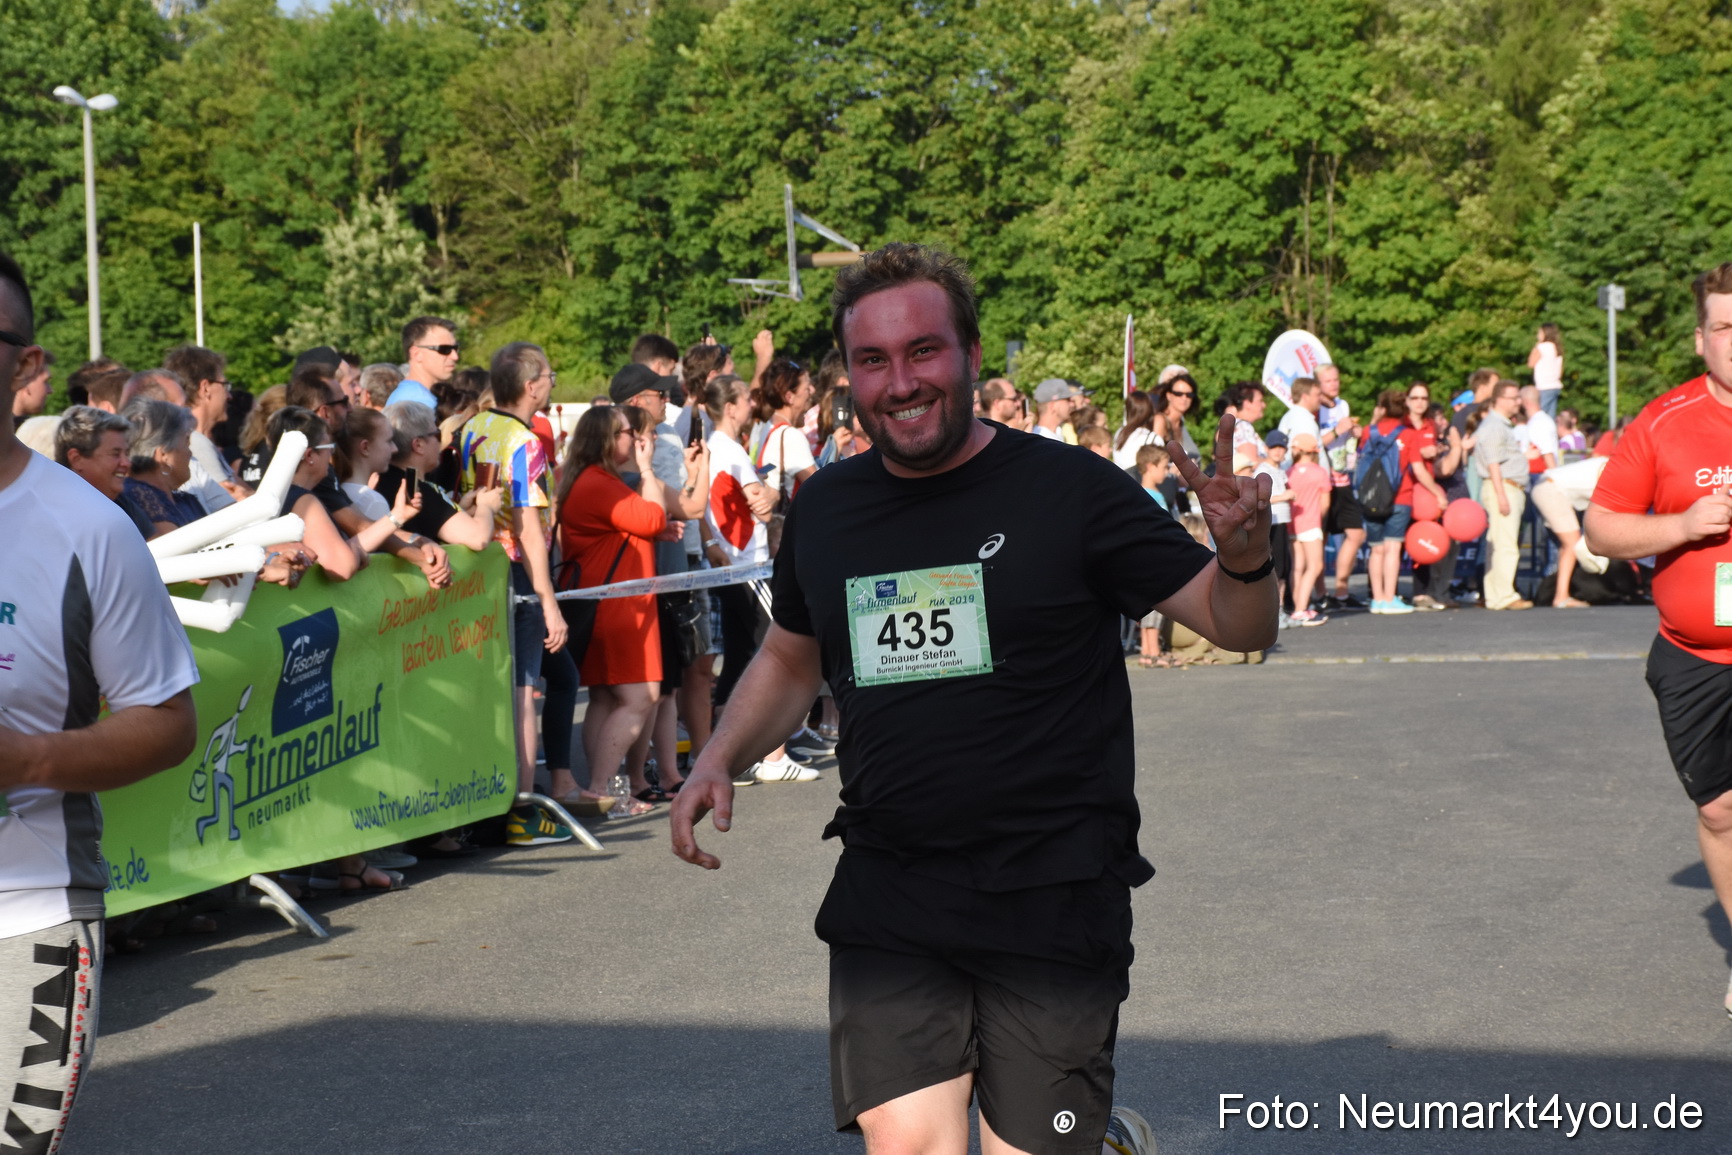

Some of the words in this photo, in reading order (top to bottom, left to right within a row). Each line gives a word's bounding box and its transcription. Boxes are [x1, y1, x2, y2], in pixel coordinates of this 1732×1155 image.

[867, 592, 917, 609] firmenlauf
[949, 594, 975, 606] 2019
[402, 624, 447, 674] laufen
[448, 600, 500, 660] länger!
[877, 608, 954, 652] 435
[290, 648, 330, 677] Fischer
[881, 651, 919, 665] Dinauer
[922, 648, 956, 661] Stefan
[905, 660, 938, 673] Ingenieur
[939, 659, 963, 668] GmbH
[246, 682, 383, 802] firmenlauf
[248, 782, 311, 829] neumarkt
[350, 763, 507, 831] www.firmenlauf-oberpfalz.de
